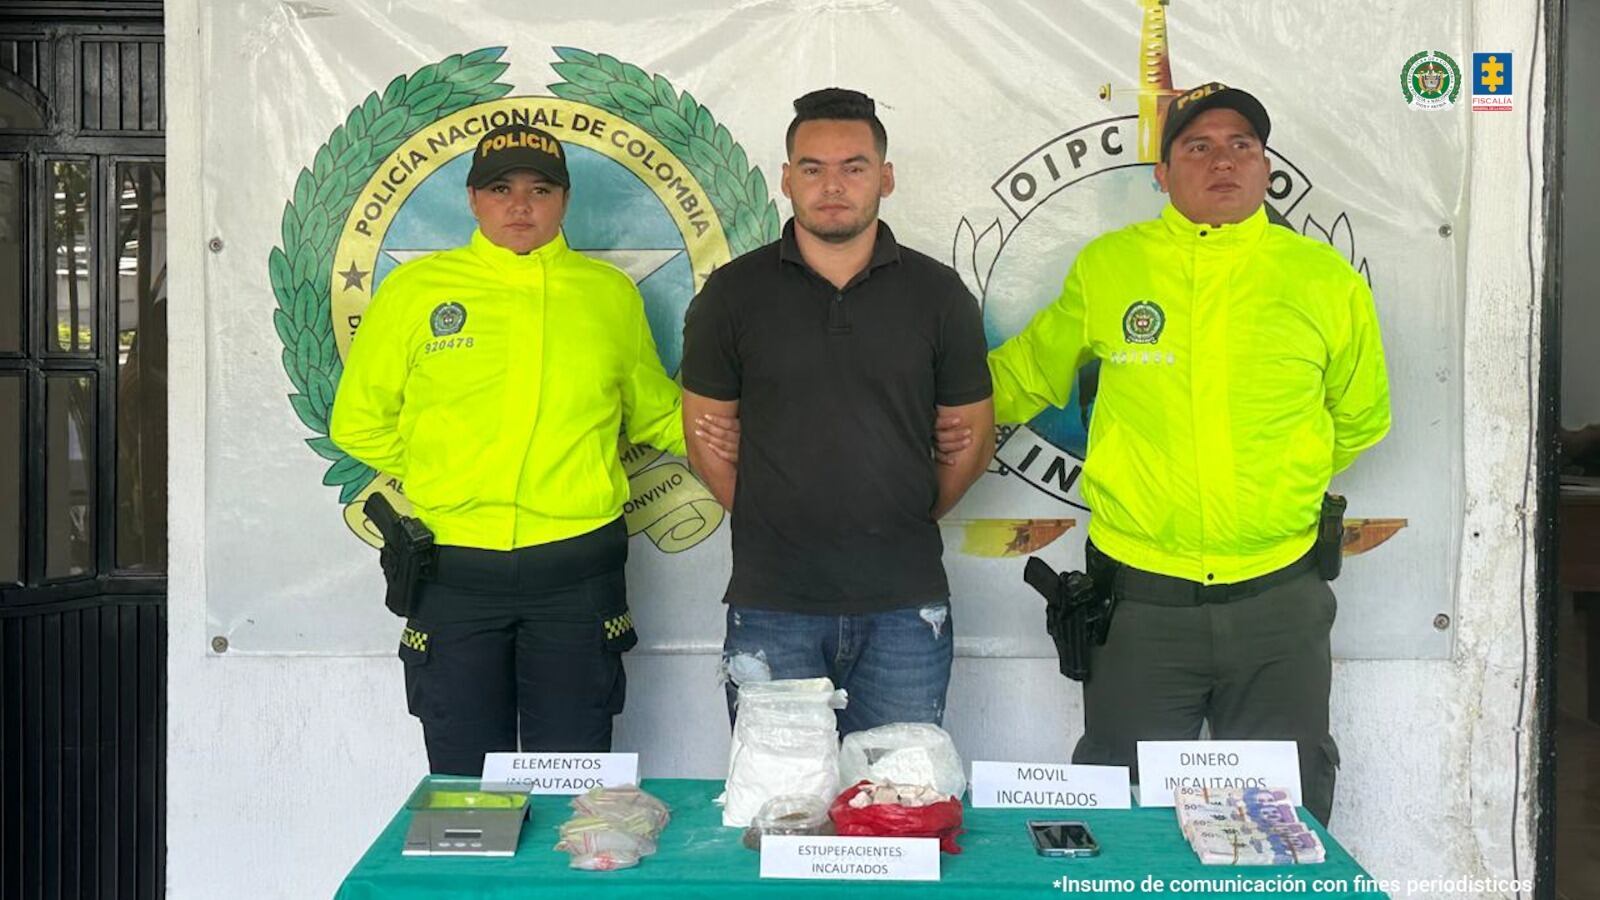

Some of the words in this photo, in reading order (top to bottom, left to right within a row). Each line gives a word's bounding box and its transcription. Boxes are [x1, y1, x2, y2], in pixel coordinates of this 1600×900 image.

[481, 131, 560, 159] POLICIA
[1009, 126, 1124, 202] OIPC
[354, 149, 429, 237] POLICÍA
[426, 108, 564, 154] NACIONAL
[571, 114, 606, 139] DE
[611, 130, 710, 238] COLOMBIA
[424, 337, 474, 355] 920478
[623, 473, 683, 514] ONVIVIO
[512, 758, 602, 770] ELEMENTOS
[1179, 752, 1240, 768] DINERO
[1017, 767, 1069, 783] MOVIL
[1164, 776, 1268, 790] INCAUTADOS
[996, 789, 1099, 808] INCAUTADOS
[797, 844, 903, 858] ESTUPEFACIENTES
[811, 862, 889, 875] INCAUTADOS
